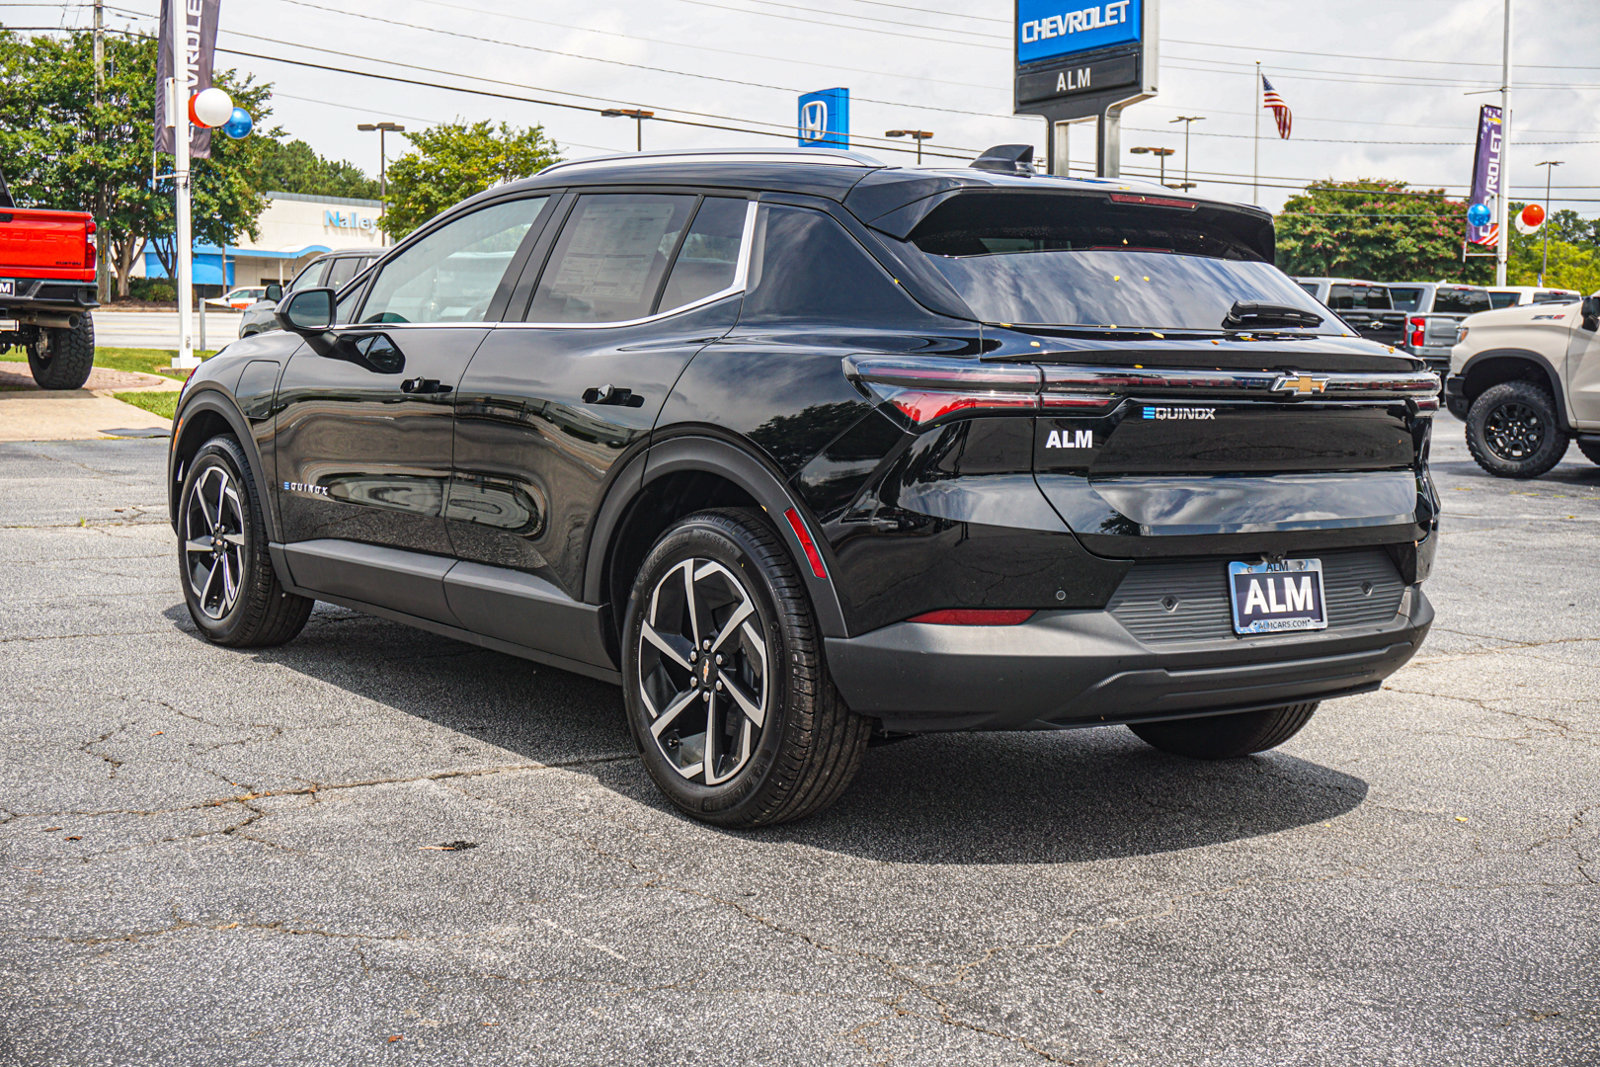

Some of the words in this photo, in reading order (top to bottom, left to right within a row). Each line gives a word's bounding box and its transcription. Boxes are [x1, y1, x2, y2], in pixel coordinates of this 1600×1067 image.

[1022, 0, 1130, 43] CHEVROLET
[1056, 67, 1091, 92] ALM
[1142, 406, 1216, 420] EQUINOX
[1045, 430, 1093, 449] ALM
[284, 482, 328, 495] EQUINOX
[1265, 561, 1289, 572] ALM
[1244, 576, 1314, 615] ALM
[1258, 620, 1308, 630] ALMCARS.COM
